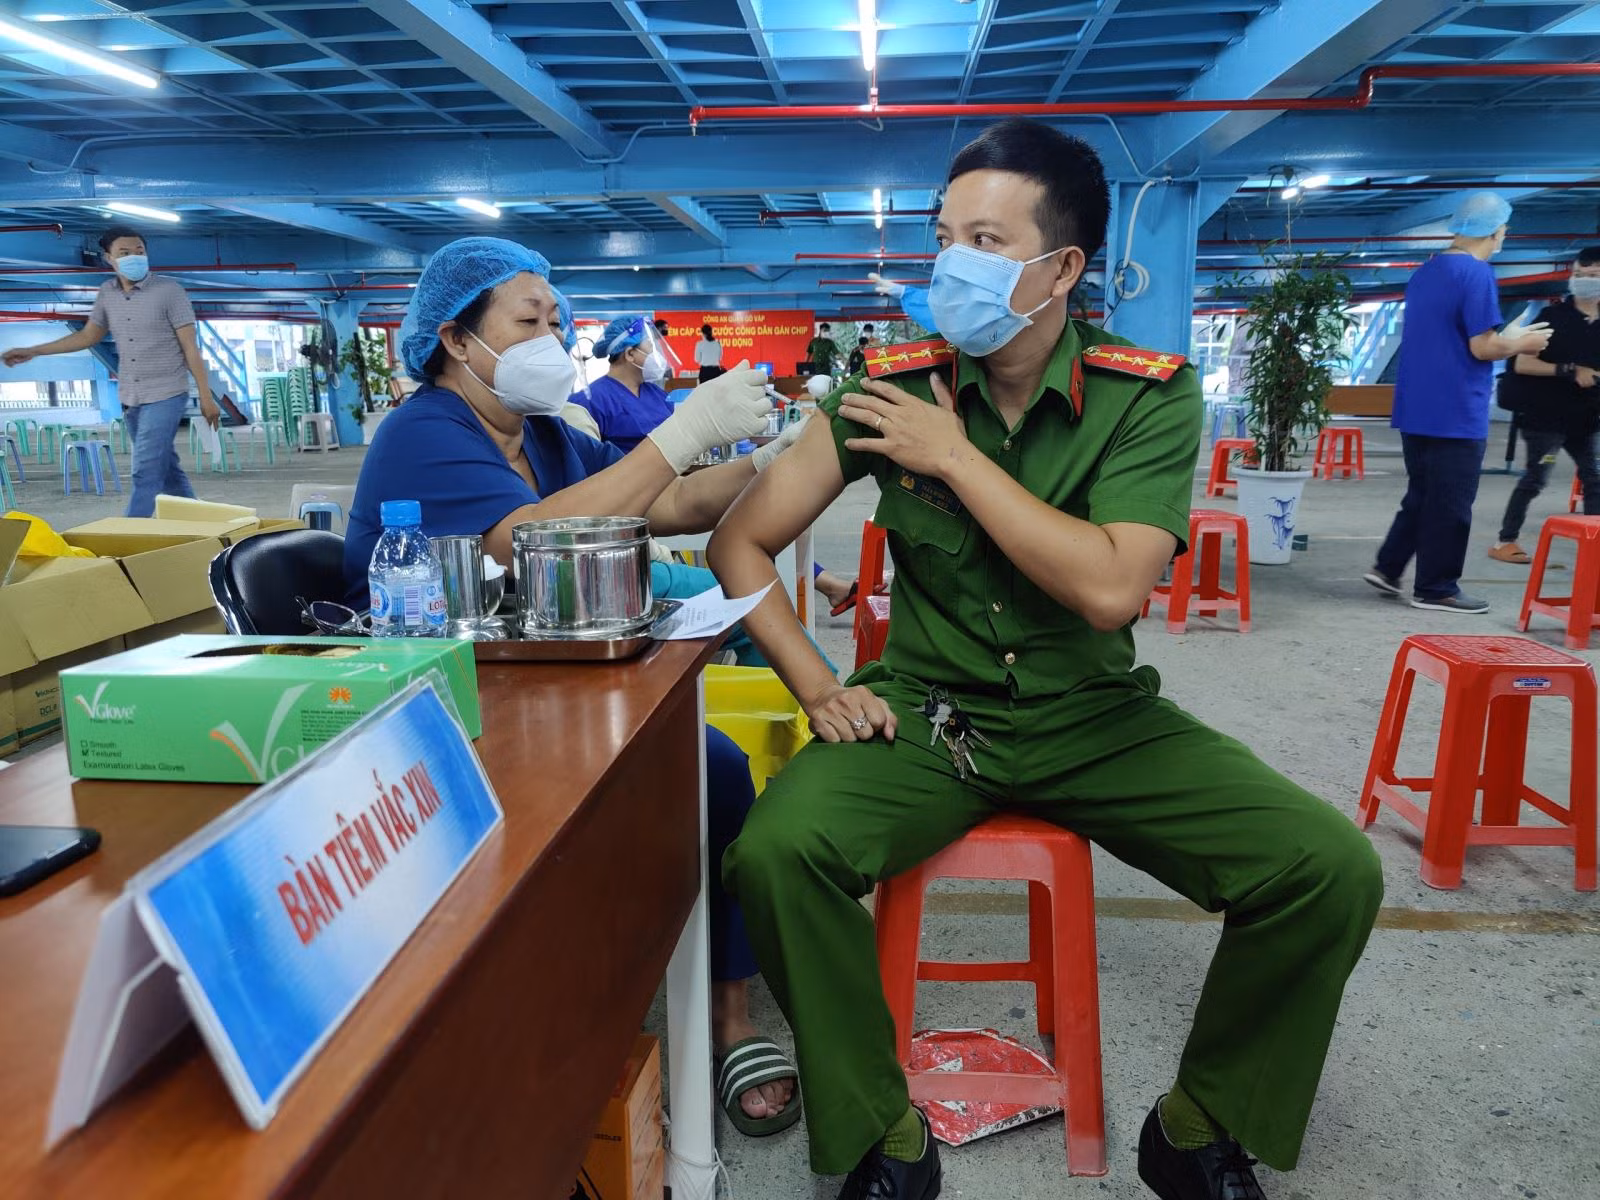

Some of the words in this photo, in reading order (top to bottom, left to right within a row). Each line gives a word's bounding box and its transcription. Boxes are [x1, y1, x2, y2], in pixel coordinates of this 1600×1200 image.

[735, 325, 756, 336] CÔNG
[791, 326, 808, 335] CHIP
[91, 750, 122, 758] Textured
[83, 761, 134, 769] Examination
[136, 762, 156, 770] Latex
[278, 855, 343, 945] BÀN
[324, 812, 389, 898] TIÊM
[370, 768, 418, 853] VẮC
[402, 760, 443, 825] XIN
